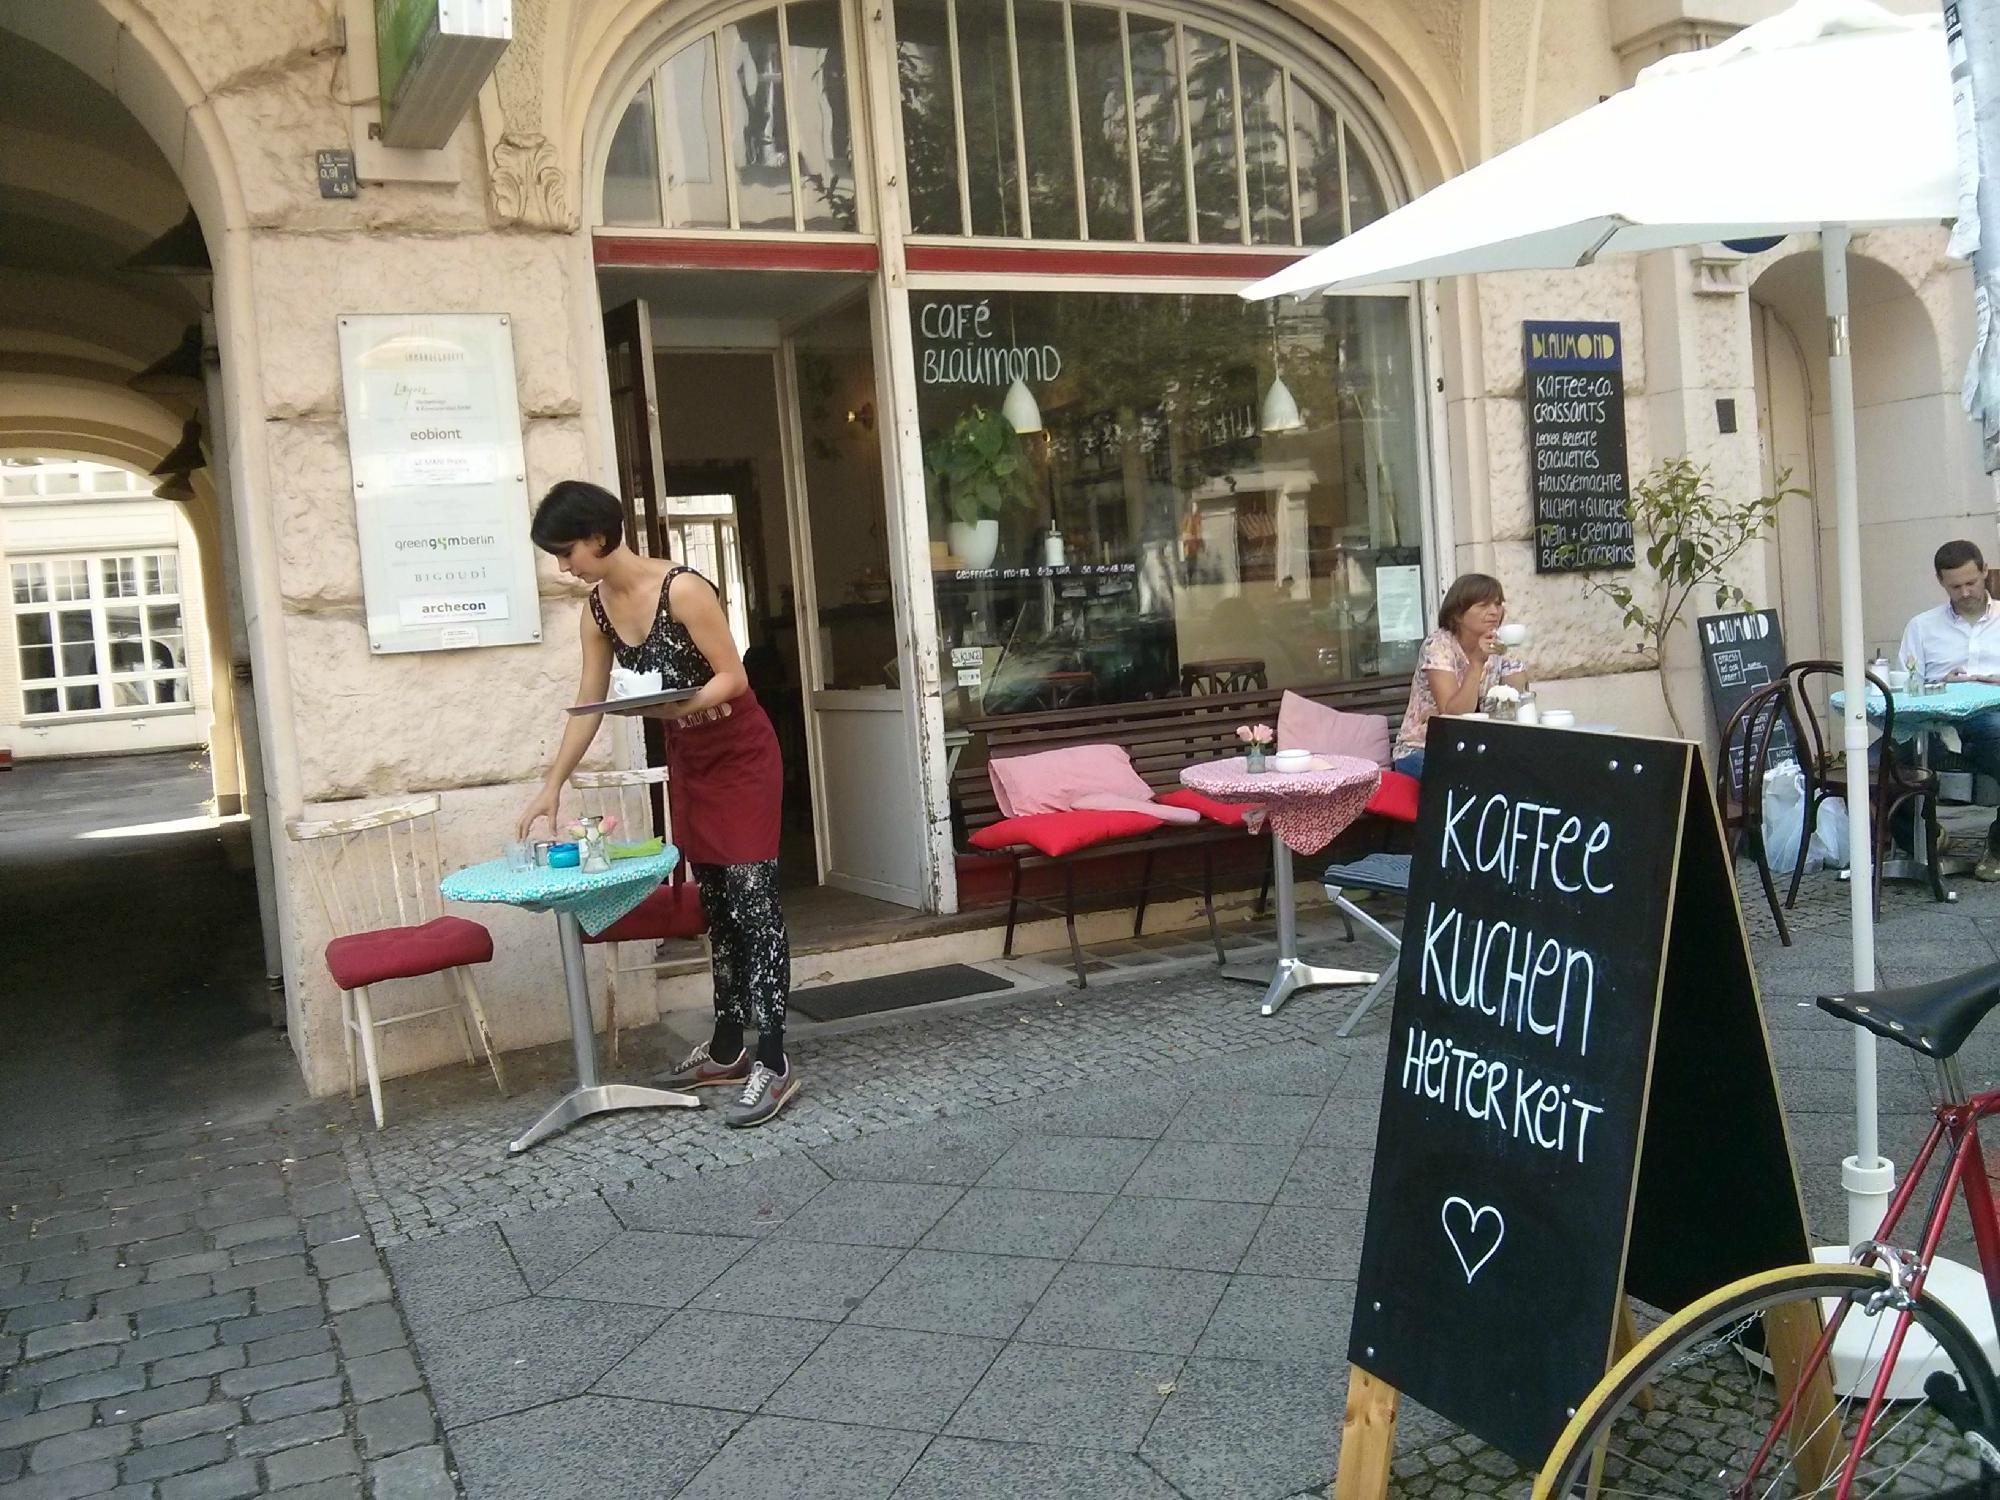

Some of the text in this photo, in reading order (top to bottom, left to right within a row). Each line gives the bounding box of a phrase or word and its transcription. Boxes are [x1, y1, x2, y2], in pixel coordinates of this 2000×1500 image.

[1532, 333, 1615, 359] BLAUMOND
[410, 428, 463, 441] eobiont
[421, 601, 487, 614] archecon
[1705, 613, 1769, 645] BLAUMOND
